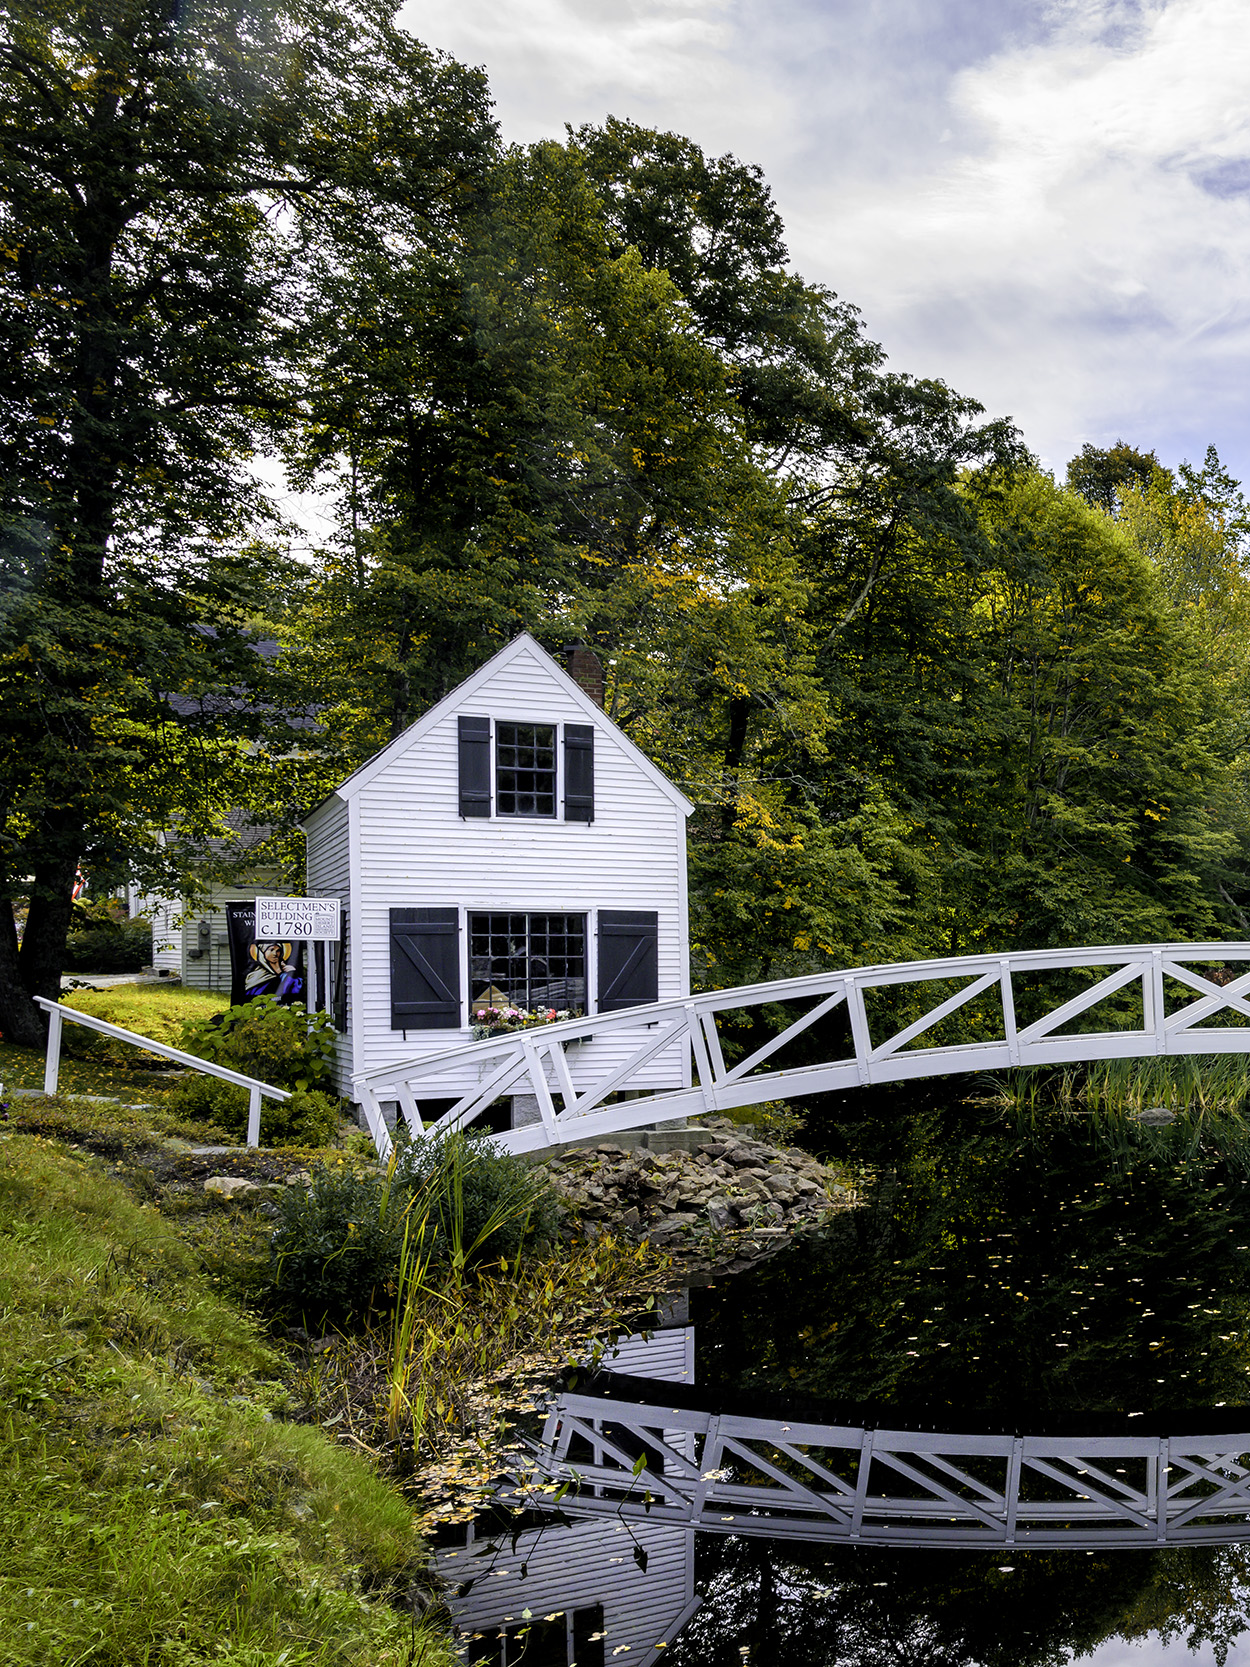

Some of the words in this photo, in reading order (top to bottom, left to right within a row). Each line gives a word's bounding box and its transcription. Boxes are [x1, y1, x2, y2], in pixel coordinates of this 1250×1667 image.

[261, 902, 335, 912] SELECTMEN'S
[261, 912, 313, 921] BUILDING
[261, 922, 313, 935] c.1780
